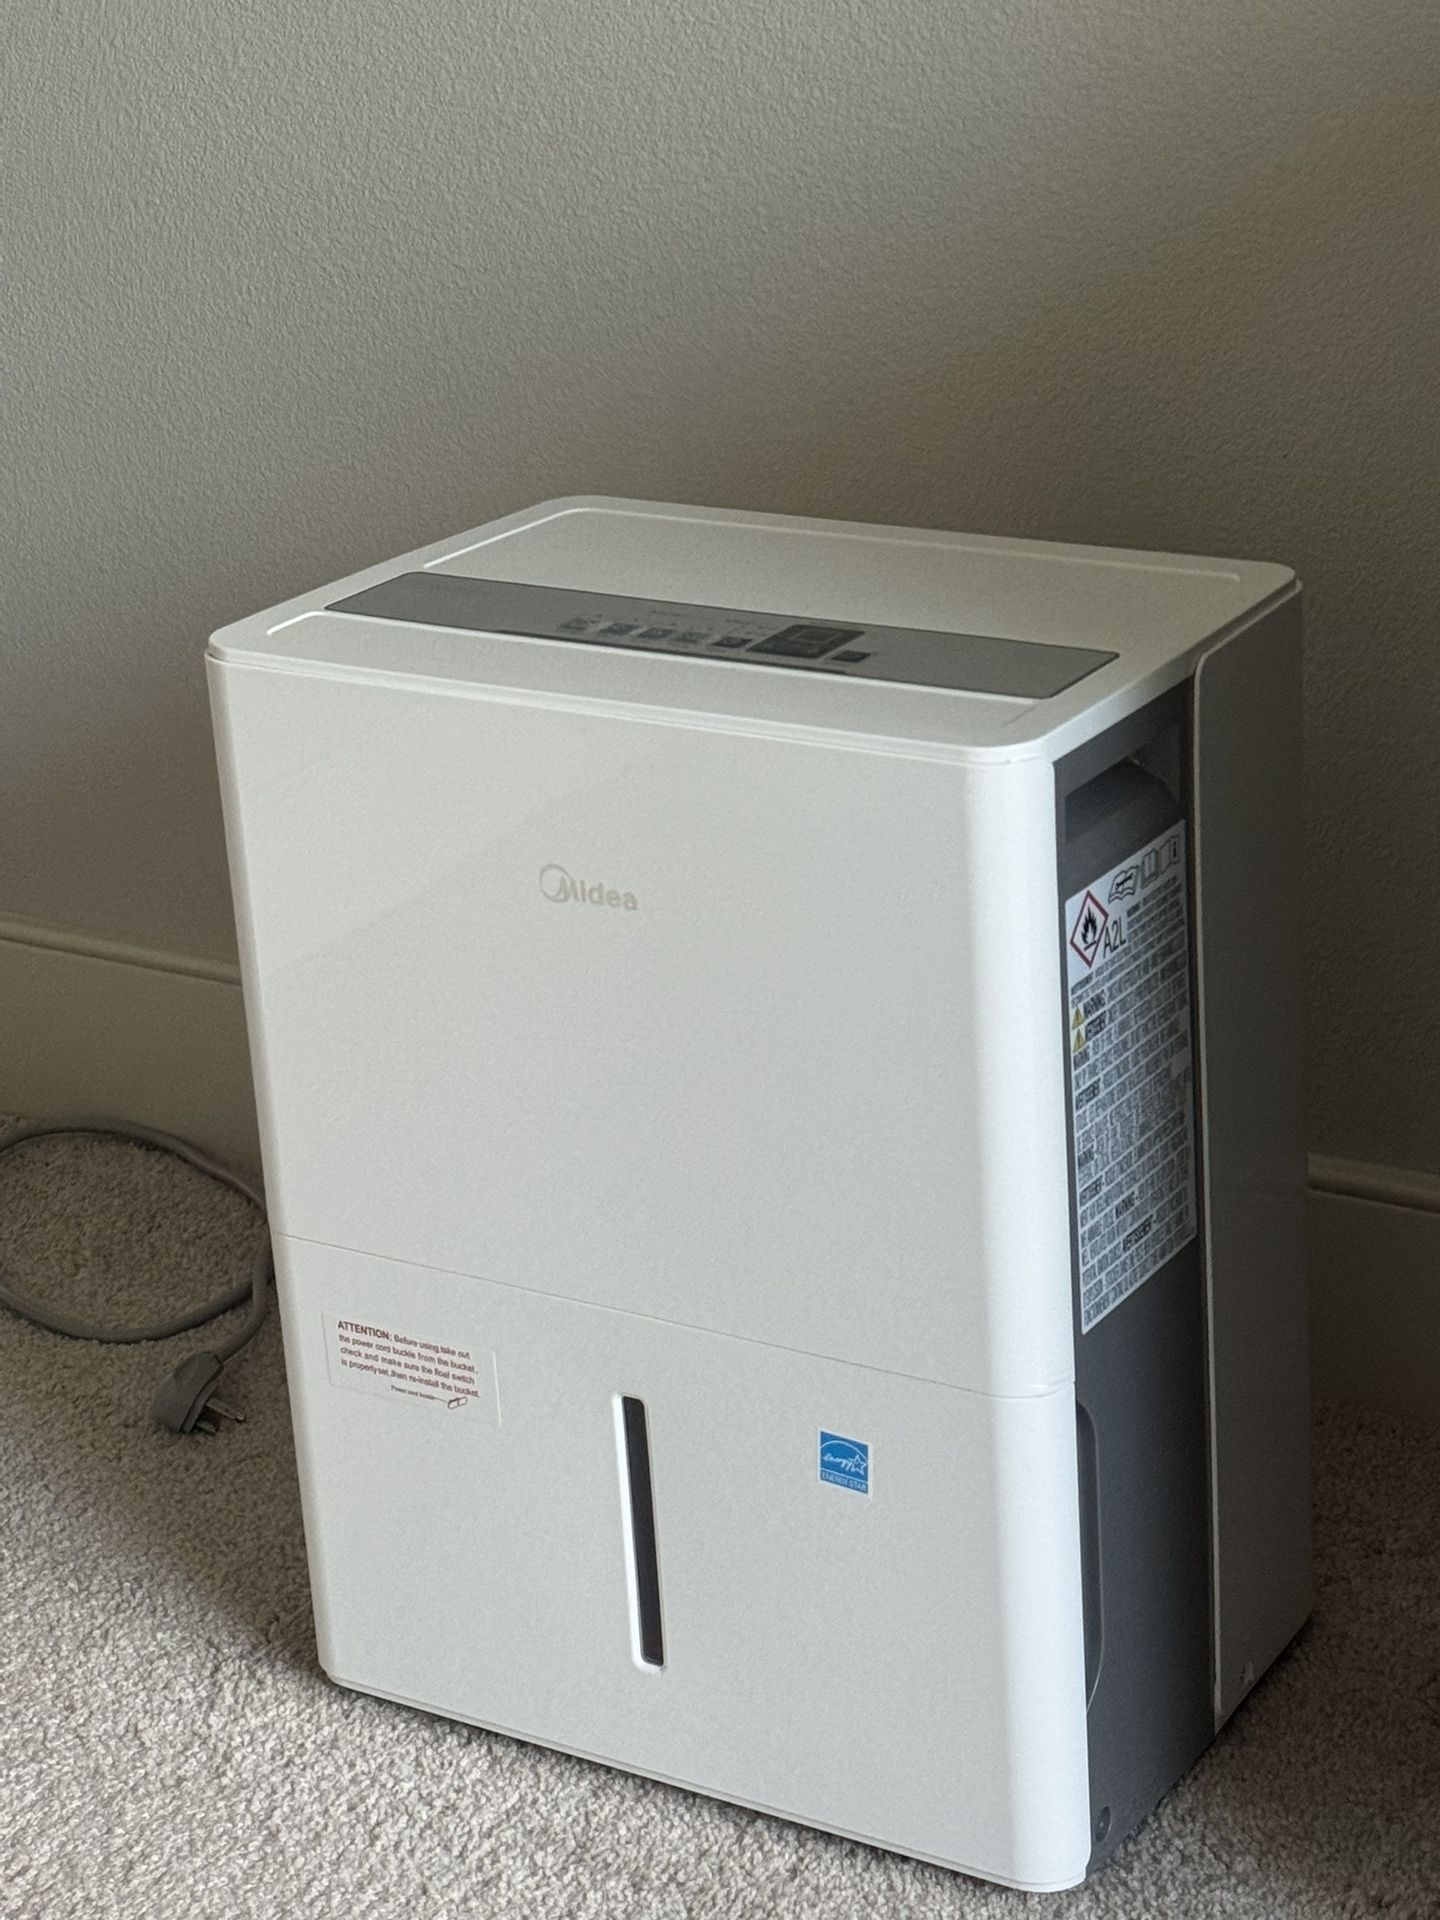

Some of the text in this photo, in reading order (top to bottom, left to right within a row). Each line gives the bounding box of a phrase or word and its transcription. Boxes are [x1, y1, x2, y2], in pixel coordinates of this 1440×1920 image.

[540, 863, 639, 911] Midea
[1102, 916, 1127, 958] A2L
[338, 1320, 392, 1341] ATTENTION:
[394, 1334, 418, 1348] Before
[339, 1334, 350, 1344] the
[352, 1338, 374, 1348] power
[375, 1343, 391, 1353] cord
[392, 1346, 416, 1359] buckle
[418, 1352, 435, 1363] from
[437, 1357, 449, 1367] the
[340, 1347, 362, 1358] check
[364, 1352, 379, 1362] and
[381, 1356, 402, 1367] make
[404, 1362, 420, 1372] sure
[421, 1365, 433, 1375] the
[341, 1357, 347, 1366] is
[440, 1382, 453, 1392] the
